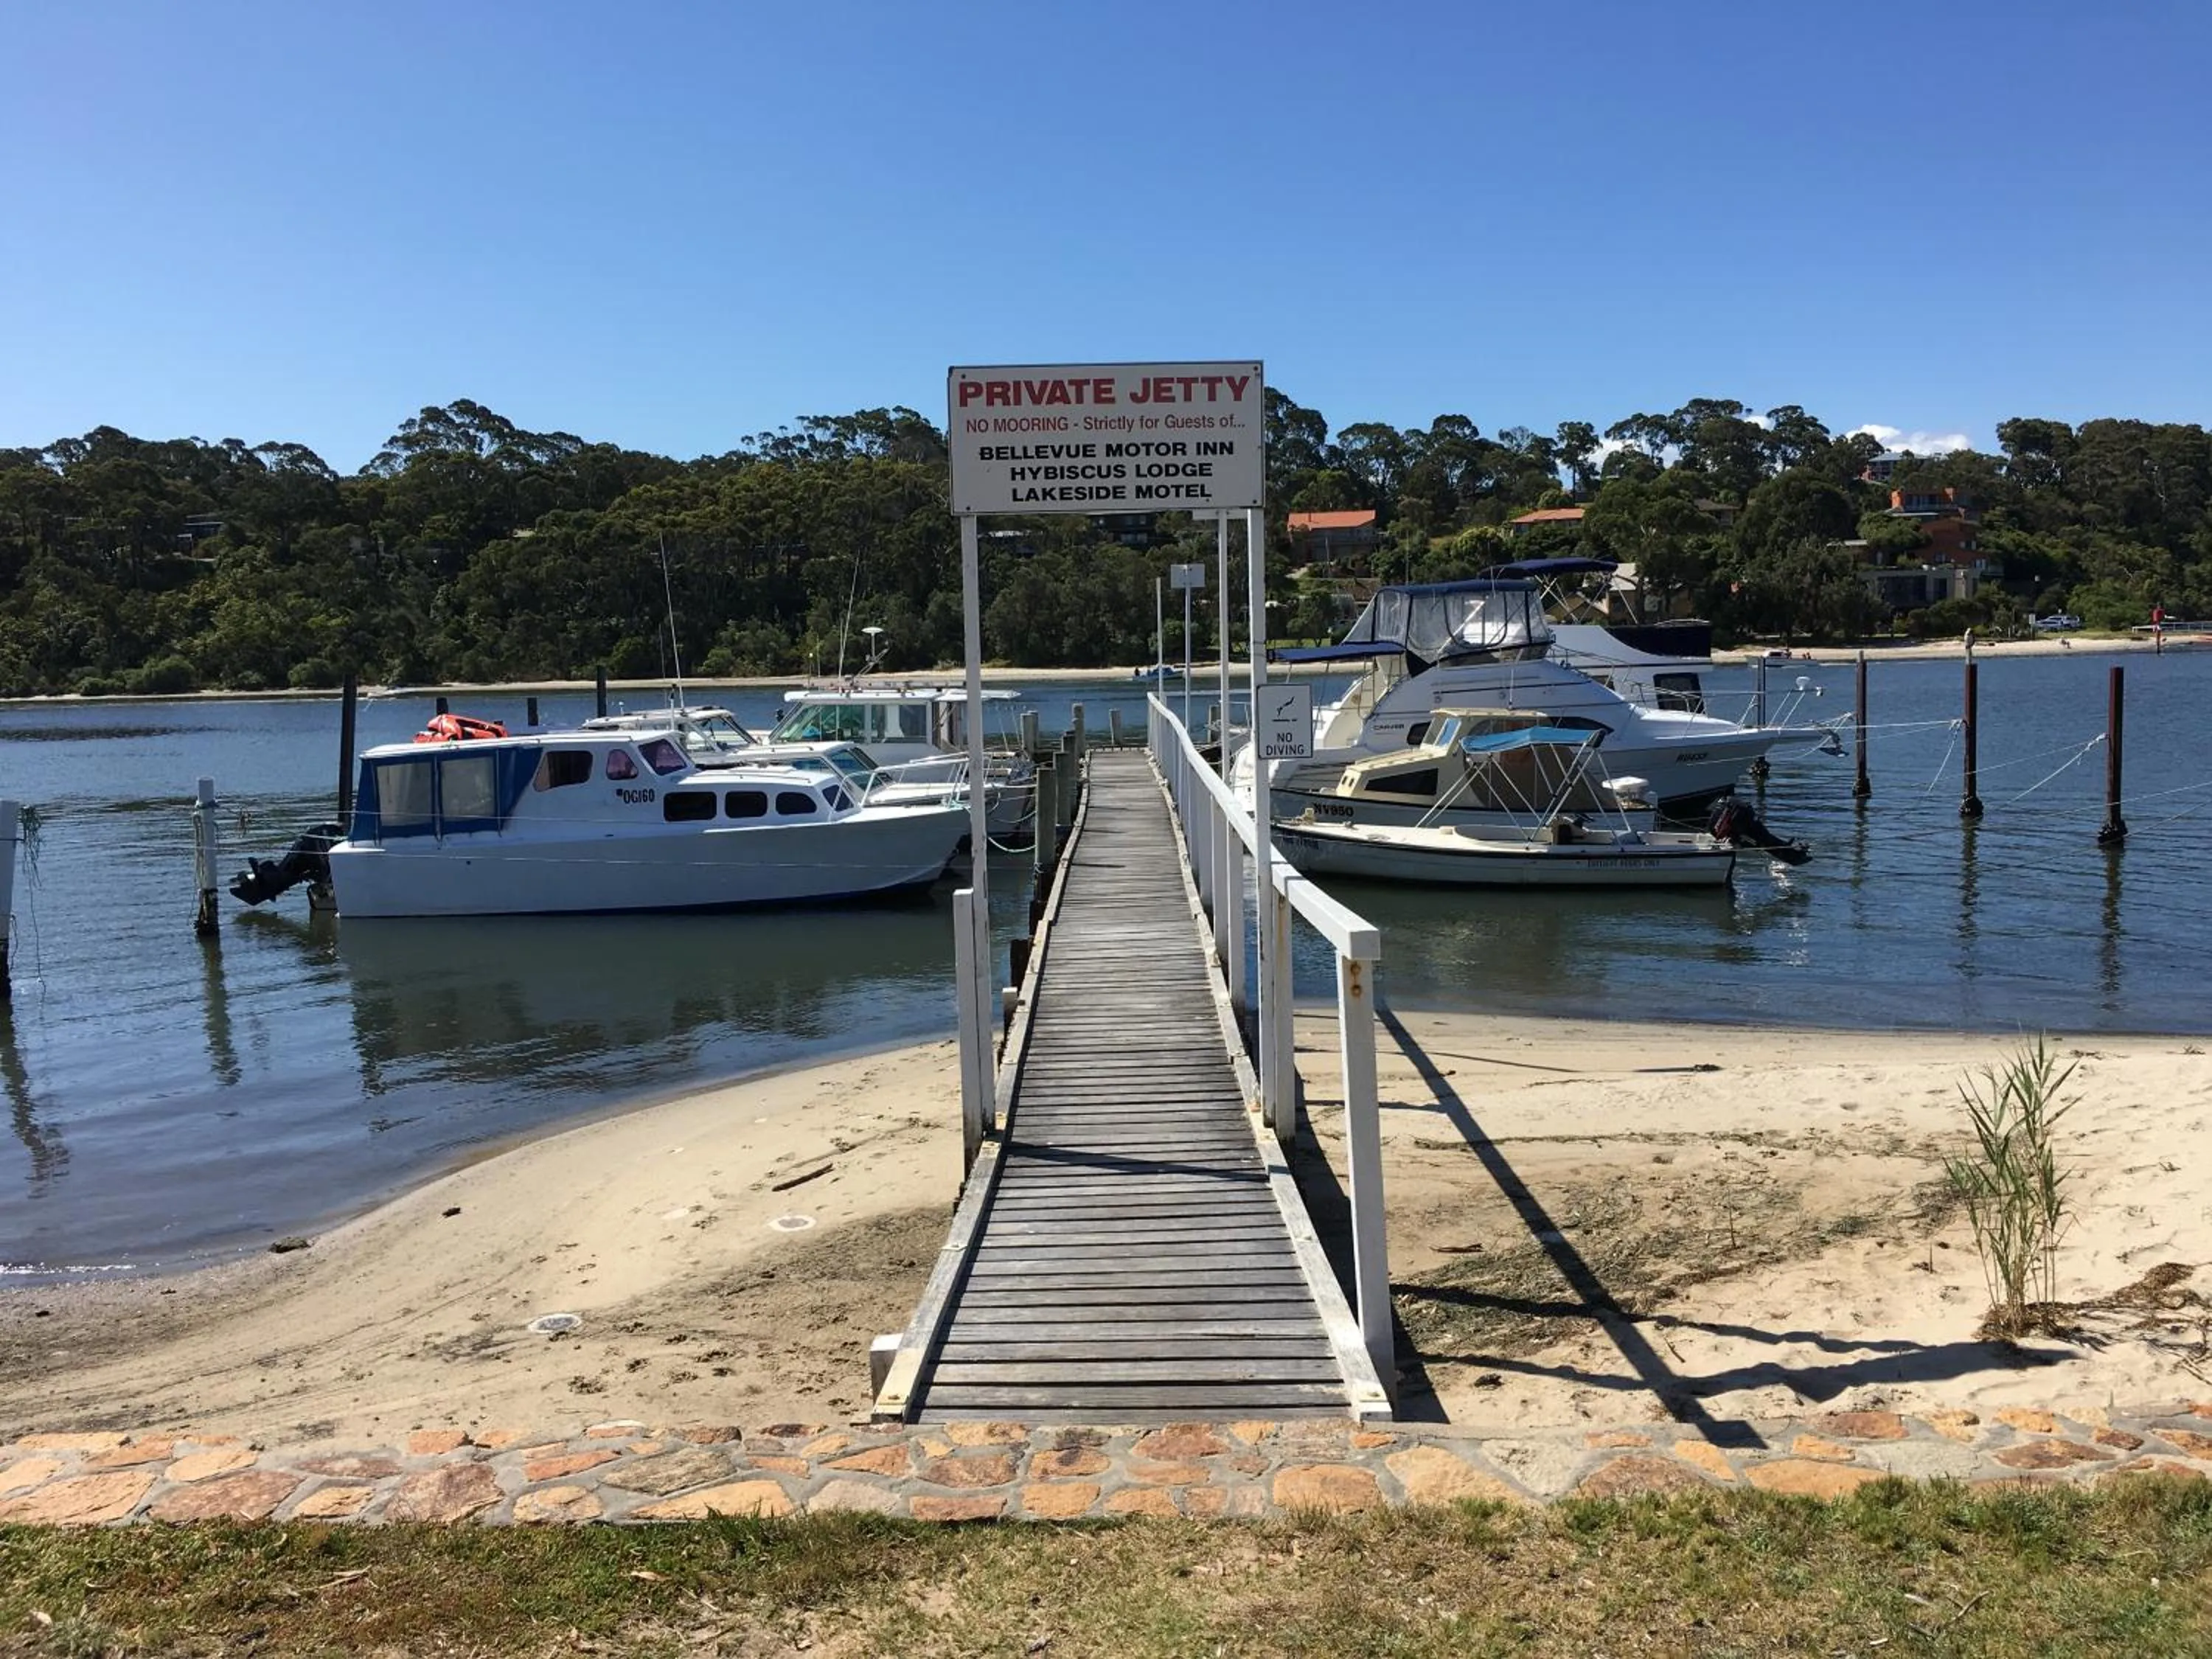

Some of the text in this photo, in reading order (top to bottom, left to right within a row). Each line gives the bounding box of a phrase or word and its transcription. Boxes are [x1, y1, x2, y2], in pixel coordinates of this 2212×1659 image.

[959, 375, 1250, 407] PRIVATE JETTY
[967, 419, 989, 434] NO
[994, 417, 1068, 433] MOORING
[1084, 415, 1134, 434] Strictly
[1140, 414, 1160, 430] for
[1165, 414, 1215, 430] Guests
[979, 441, 1234, 461] BELLEVUE MOTOR INN
[1011, 462, 1213, 481] HYBISCUS LODGE
[1012, 484, 1212, 503] LAKESIDE MOTEL
[1277, 732, 1293, 742] NO
[1266, 744, 1304, 756] DIVING
